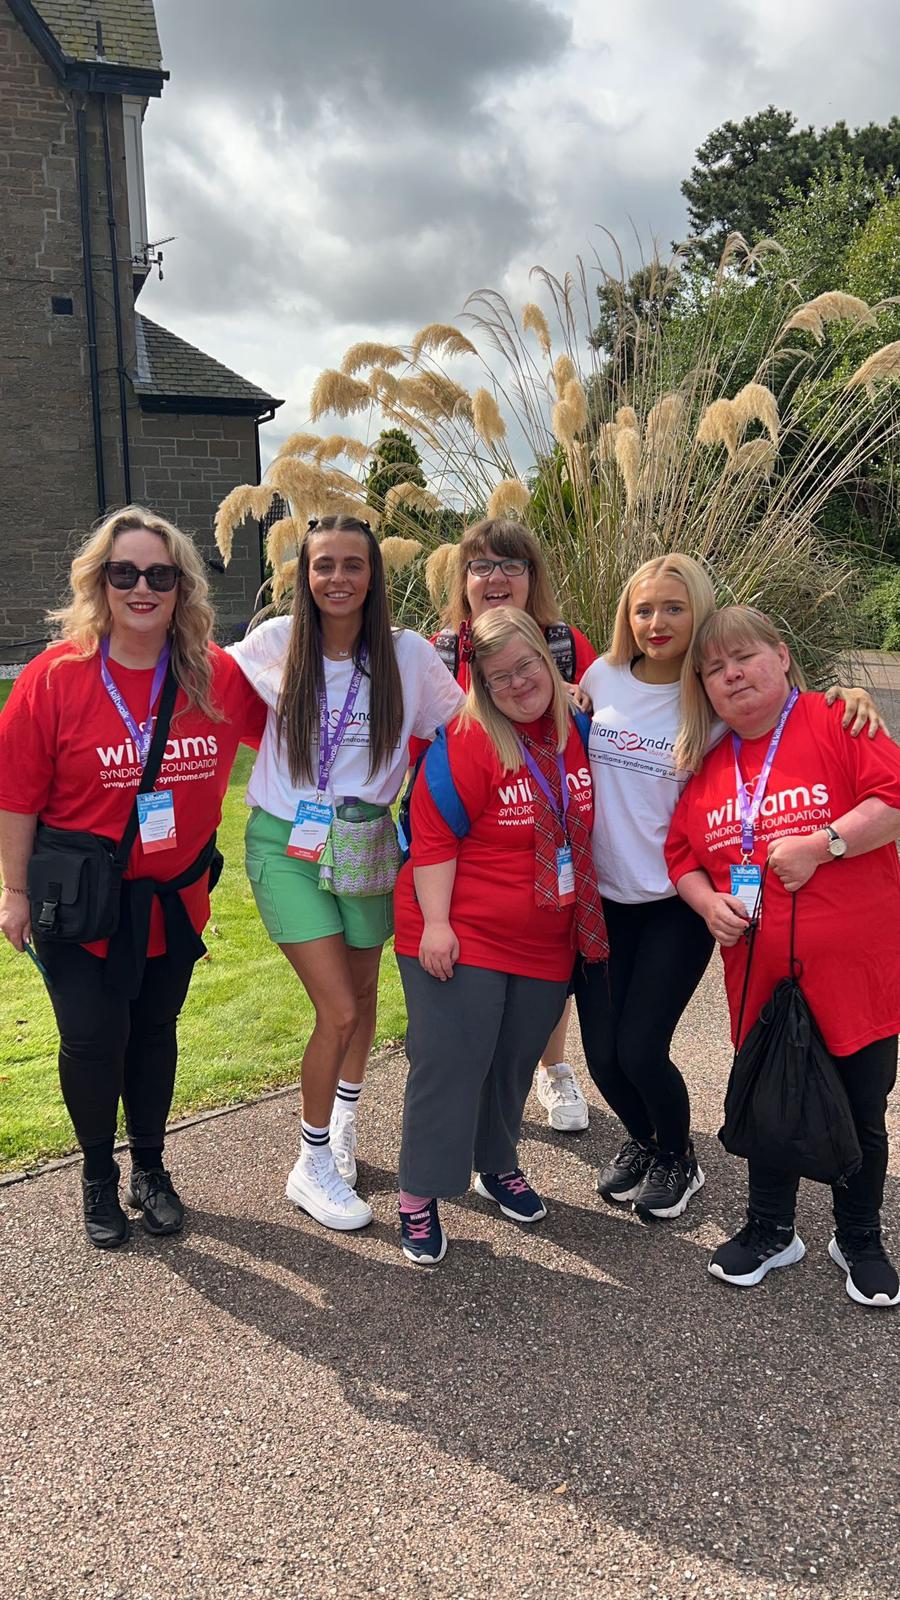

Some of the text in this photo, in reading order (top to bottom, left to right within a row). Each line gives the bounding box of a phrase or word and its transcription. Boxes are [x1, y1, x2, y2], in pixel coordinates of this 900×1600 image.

[110, 688, 129, 718] kiltwalk
[96, 736, 218, 767] wilams
[100, 758, 217, 780] SYNDRO FOUNDATION
[707, 784, 829, 829] wilams
[705, 808, 831, 843] SYNDROE FOUNDATION
